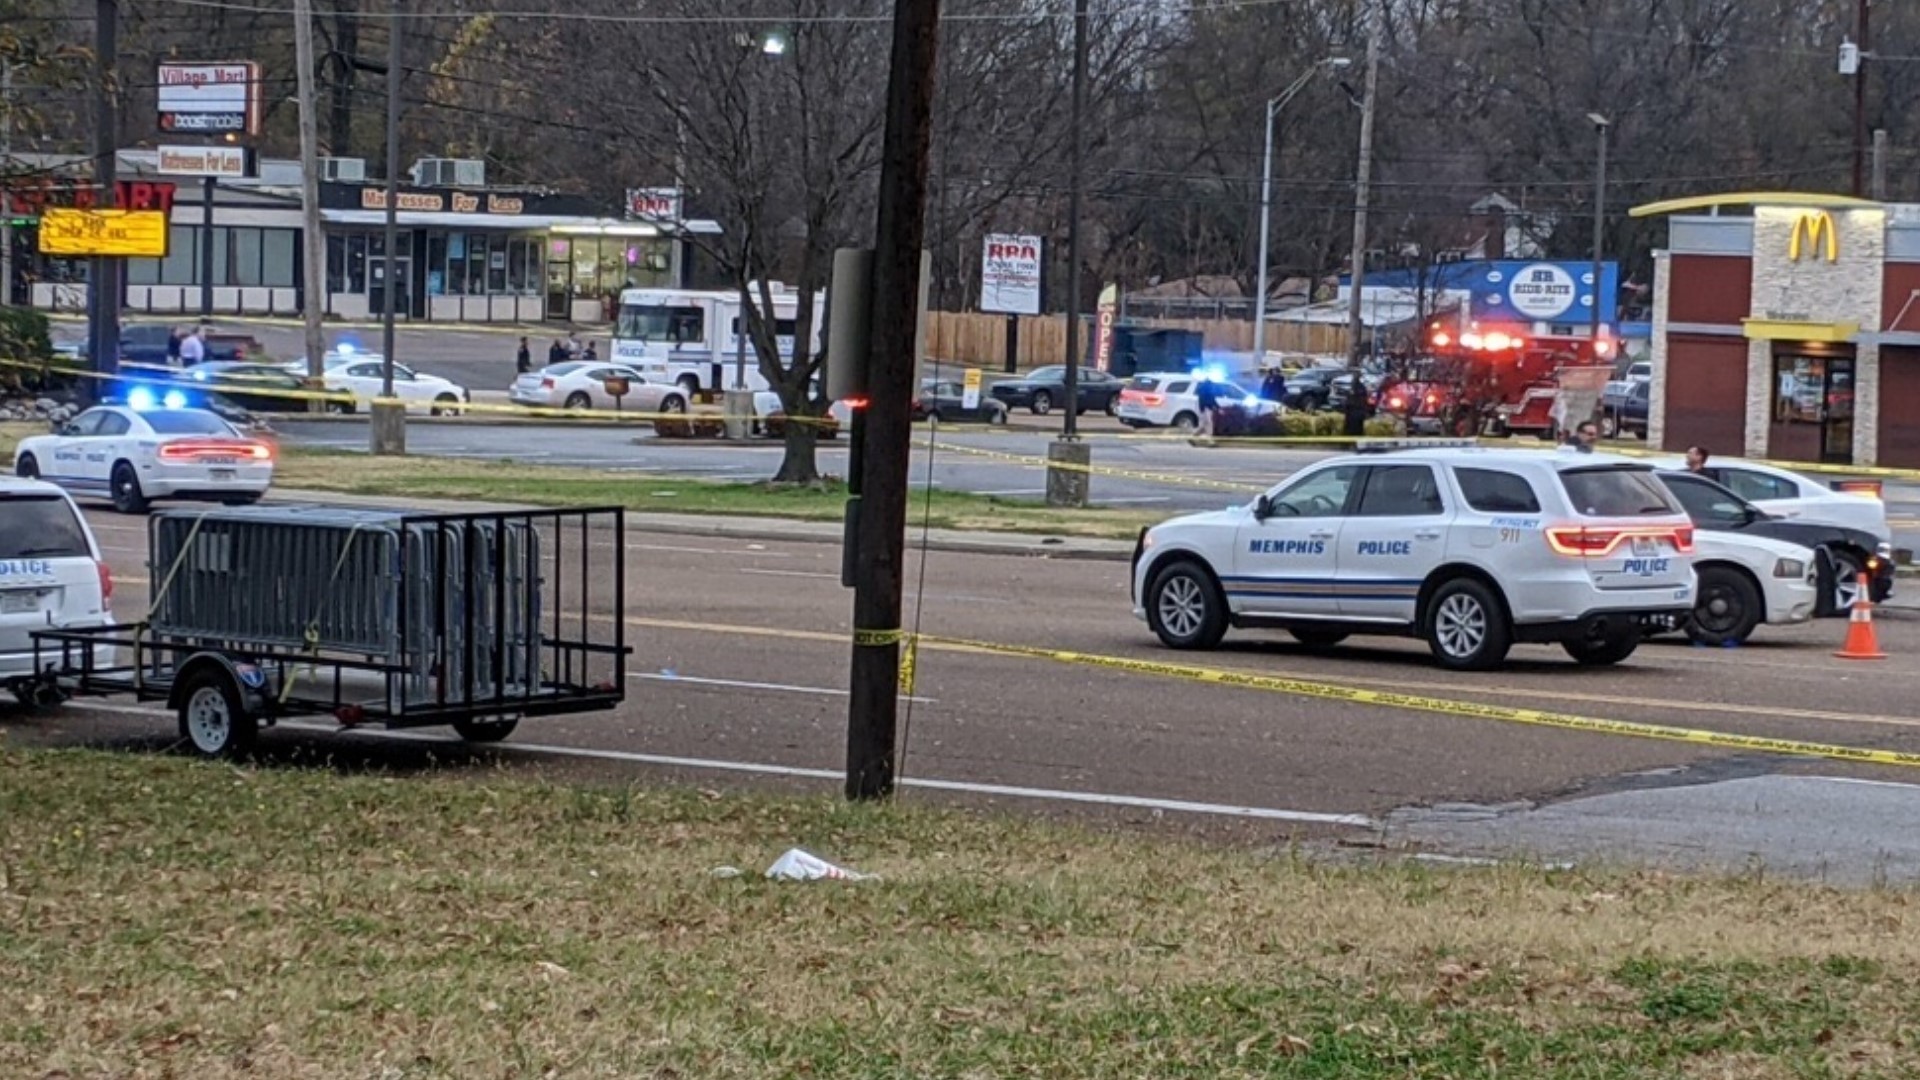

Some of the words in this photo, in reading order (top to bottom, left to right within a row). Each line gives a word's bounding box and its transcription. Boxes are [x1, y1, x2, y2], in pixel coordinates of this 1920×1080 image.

[162, 68, 207, 89] Village
[214, 68, 243, 82] Mart
[207, 151, 219, 171] For
[222, 151, 241, 171] Less
[365, 191, 439, 208] Maresses
[455, 194, 476, 210] For
[490, 196, 520, 212] Less
[1097, 312, 1113, 372] OPEN
[1490, 517, 1540, 528] EMERGENCY
[1500, 528, 1520, 543] 911
[1249, 539, 1325, 555] MEMPHIS
[1357, 540, 1413, 555] POLICE
[0, 559, 52, 575] OLICE
[1623, 558, 1670, 573] POLICE
